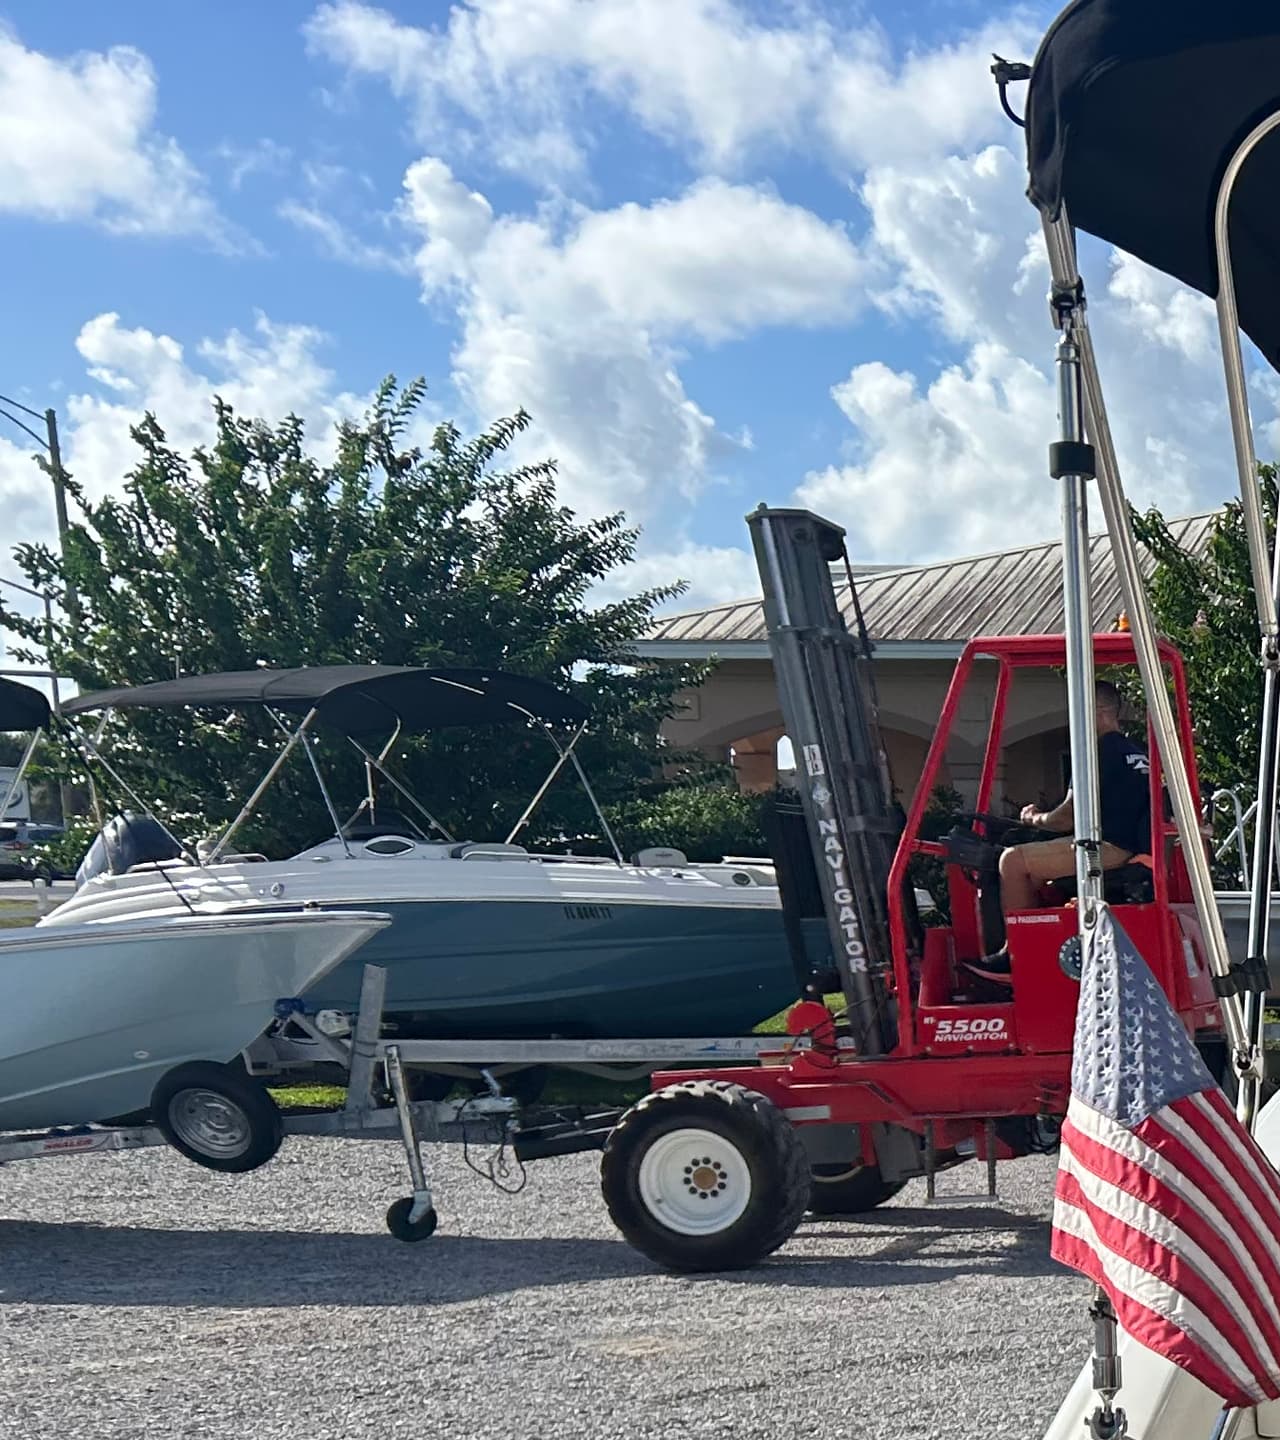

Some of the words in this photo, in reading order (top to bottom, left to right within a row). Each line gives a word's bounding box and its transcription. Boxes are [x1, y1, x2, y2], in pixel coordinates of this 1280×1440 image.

[818, 818, 868, 974] NAVIGATOR
[936, 1018, 1005, 1034] 5500
[934, 1031, 1009, 1042] NAVIGATOR
